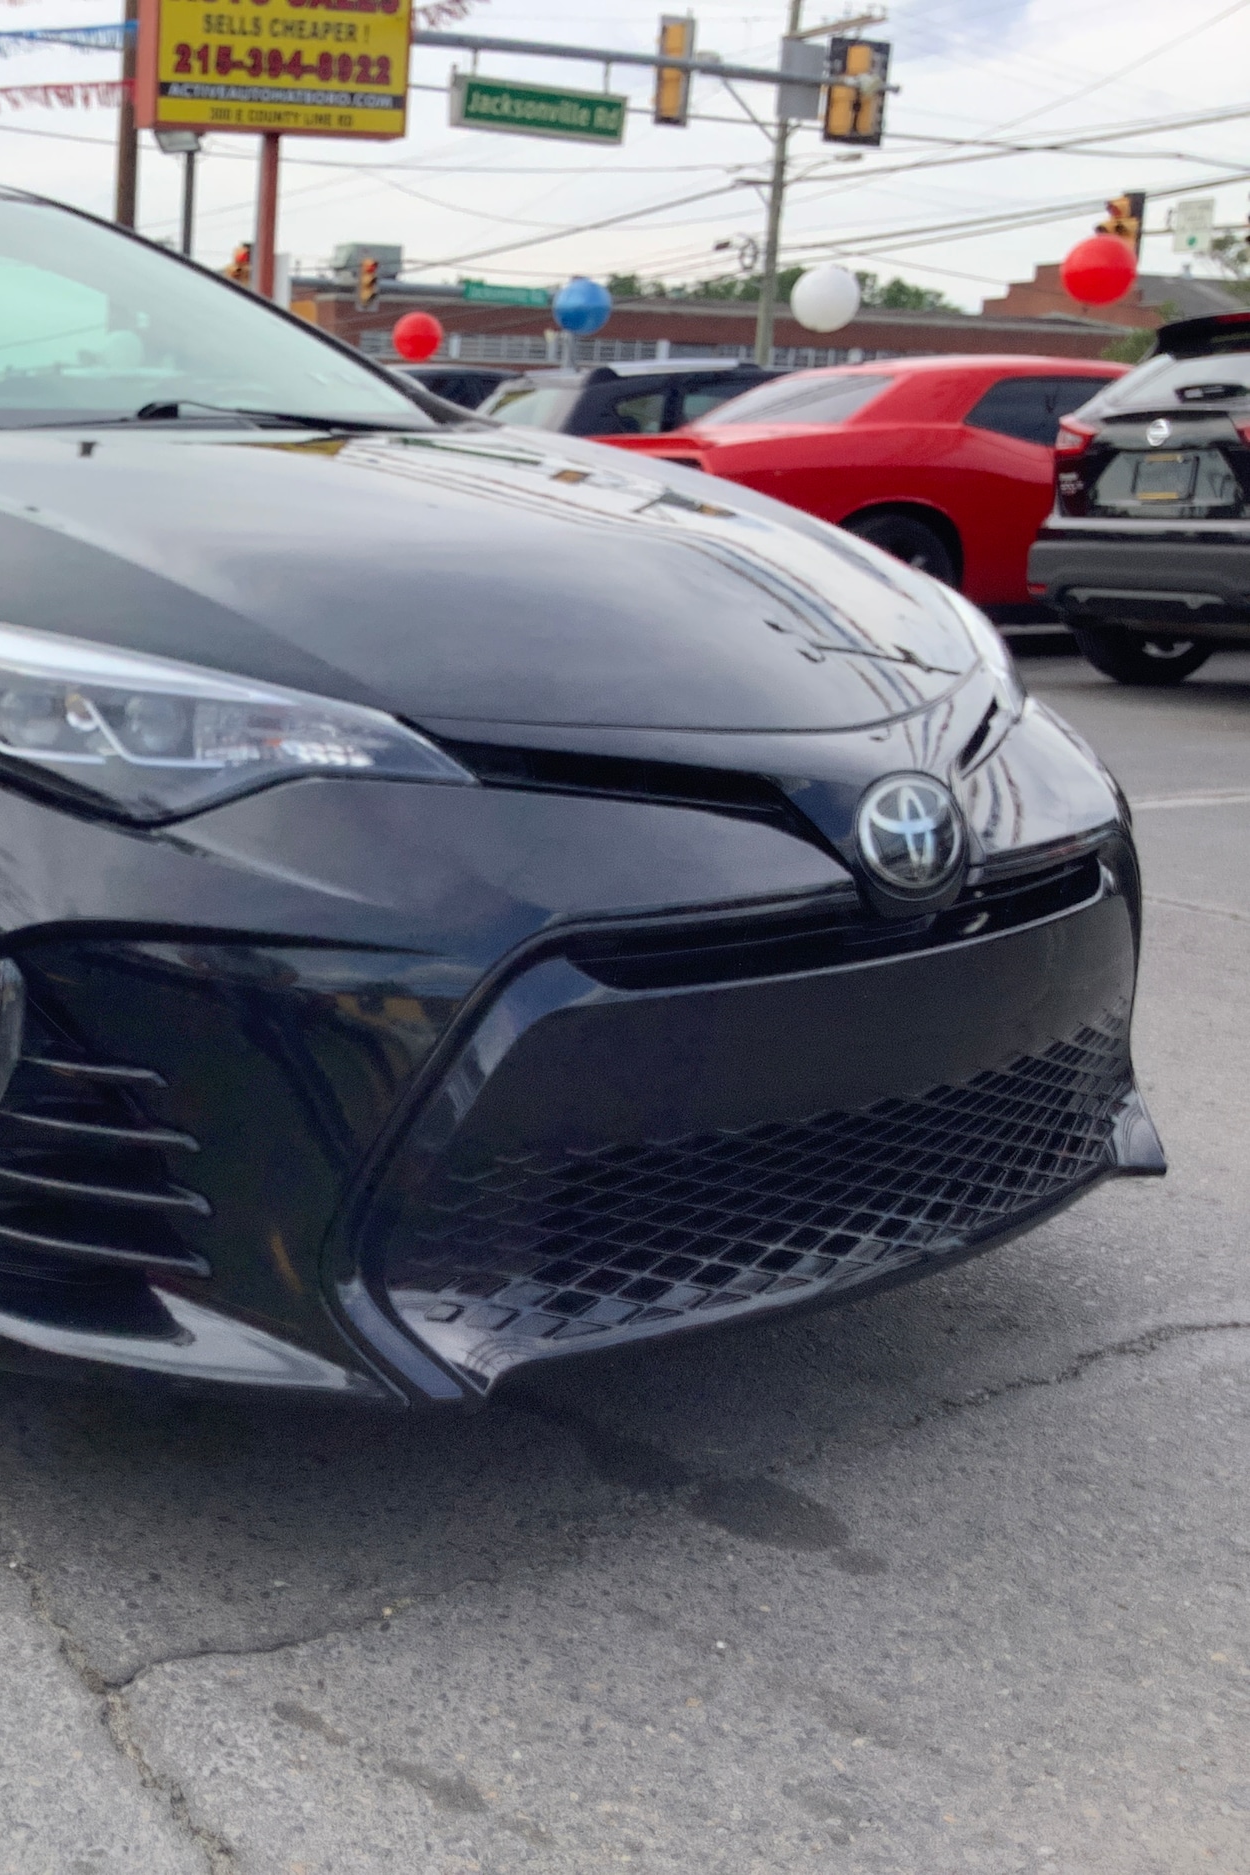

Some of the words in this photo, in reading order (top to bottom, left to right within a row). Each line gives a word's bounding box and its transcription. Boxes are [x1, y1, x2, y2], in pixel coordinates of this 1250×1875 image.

[203, 14, 261, 37] SELLS
[269, 18, 357, 43] CHEAPER
[467, 91, 591, 127] Jacksonville
[593, 106, 621, 131] Rd
